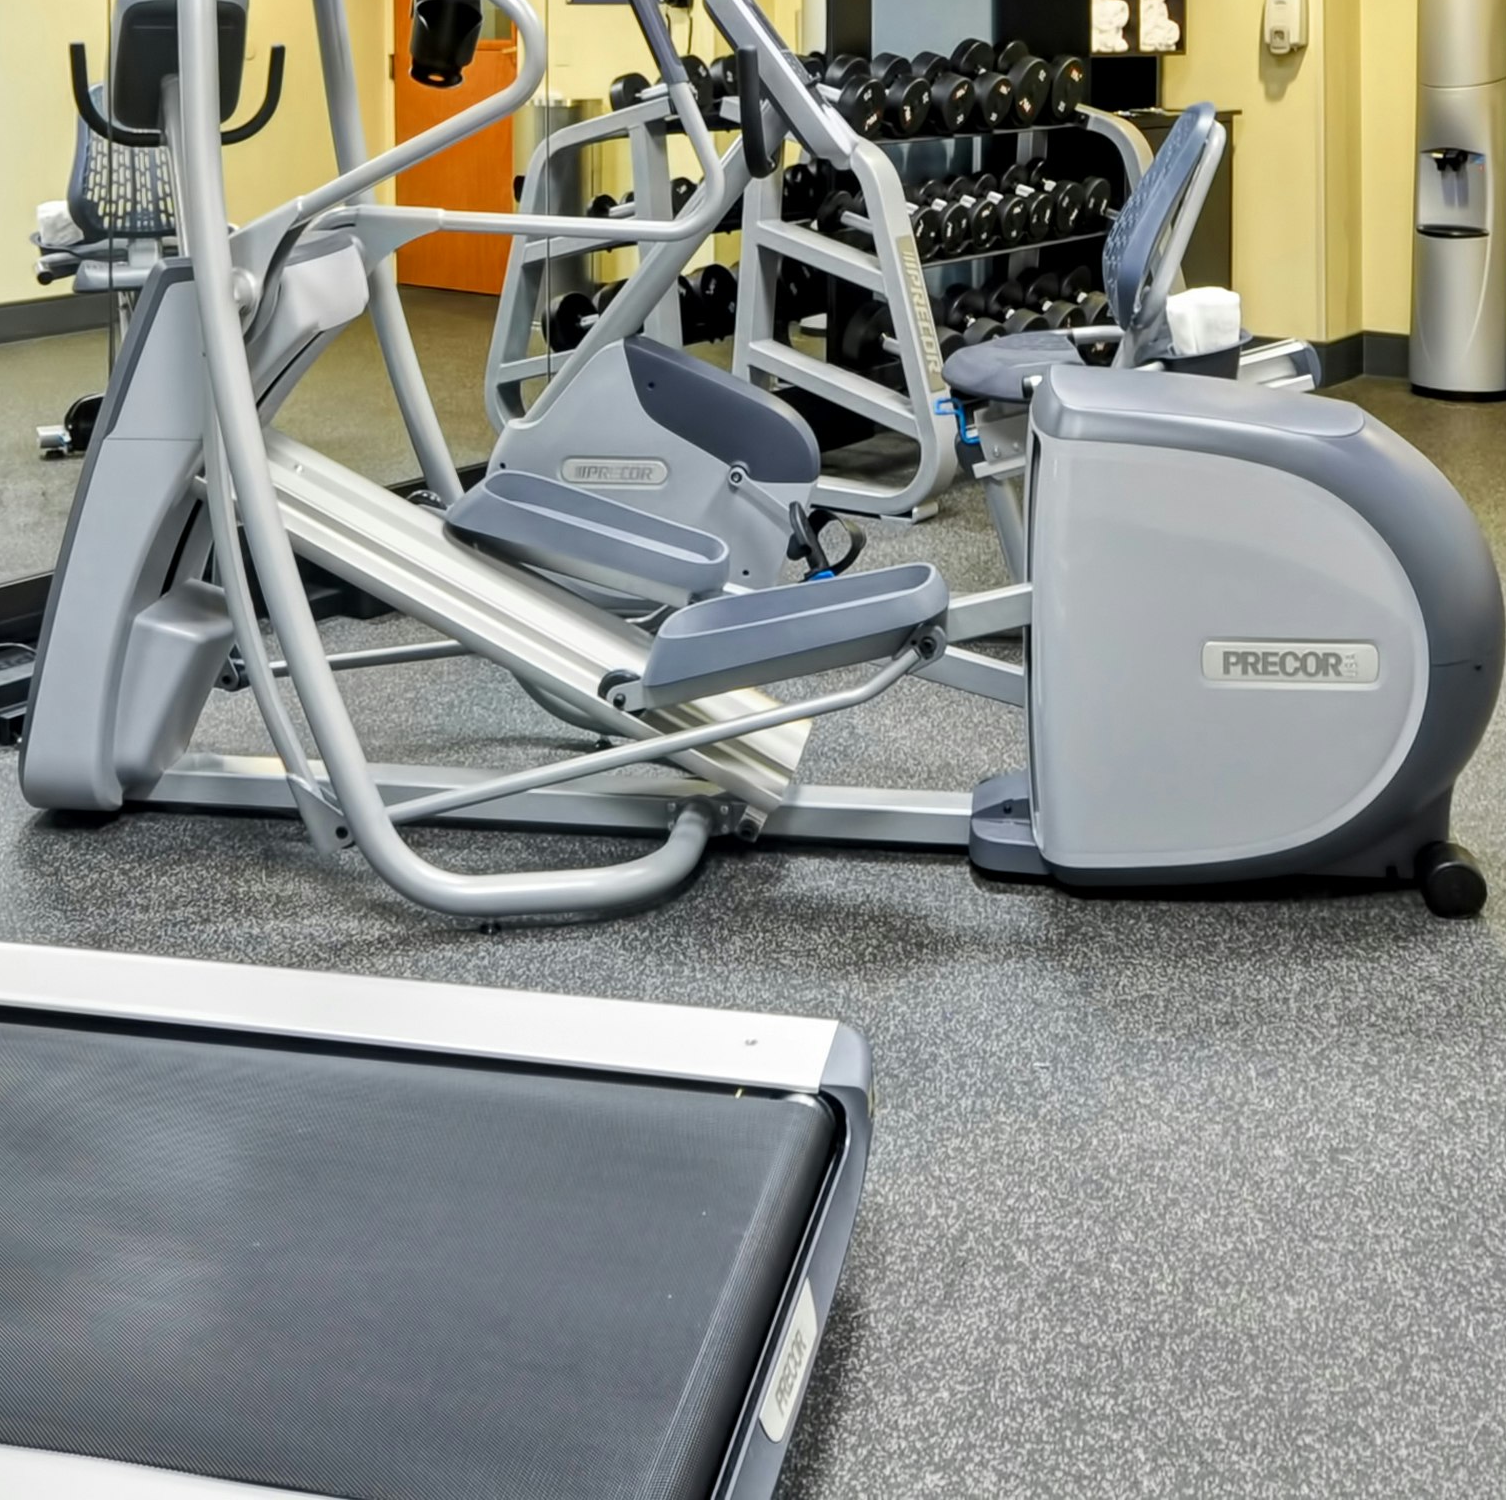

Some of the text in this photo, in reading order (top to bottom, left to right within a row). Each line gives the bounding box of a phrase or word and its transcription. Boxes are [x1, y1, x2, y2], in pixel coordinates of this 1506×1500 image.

[906, 268, 942, 376] PRECOR
[1222, 650, 1344, 678] PRECOR
[774, 1328, 808, 1419] PRECOR
